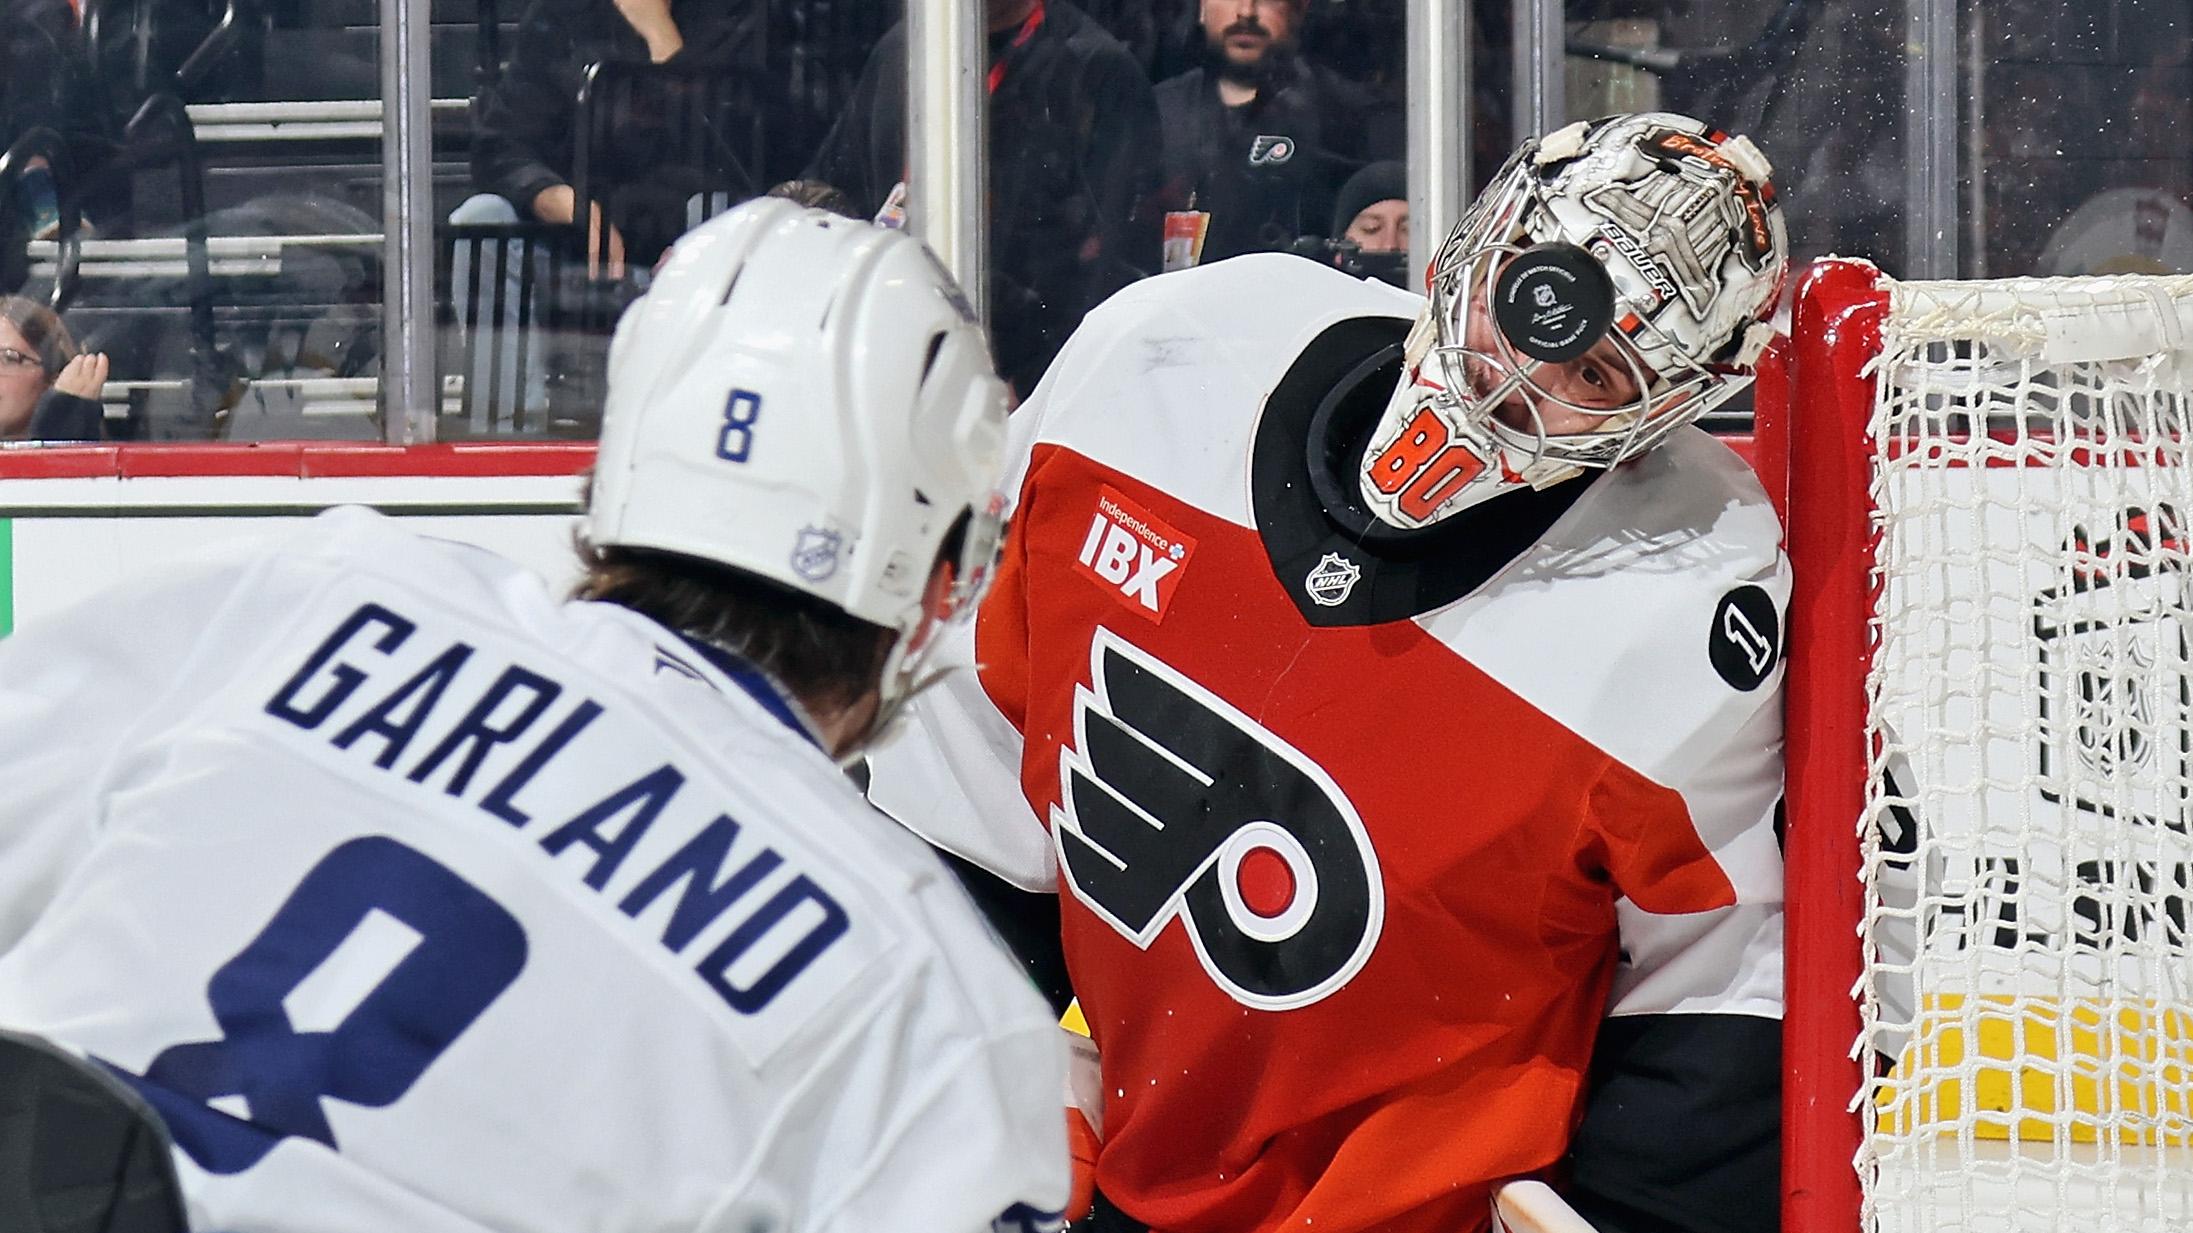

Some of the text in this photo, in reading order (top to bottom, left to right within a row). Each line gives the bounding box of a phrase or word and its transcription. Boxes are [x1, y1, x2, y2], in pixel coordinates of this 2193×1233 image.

[1661, 134, 1751, 196] Brothy
[716, 388, 761, 463] 8
[1366, 408, 1487, 522] 80
[1100, 496, 1168, 551] Independence
[1079, 512, 1178, 612] IBX
[1314, 573, 1348, 588] NHL
[1723, 602, 1772, 675] 1
[263, 602, 851, 1015] GARLAND
[95, 835, 529, 1175] 8
